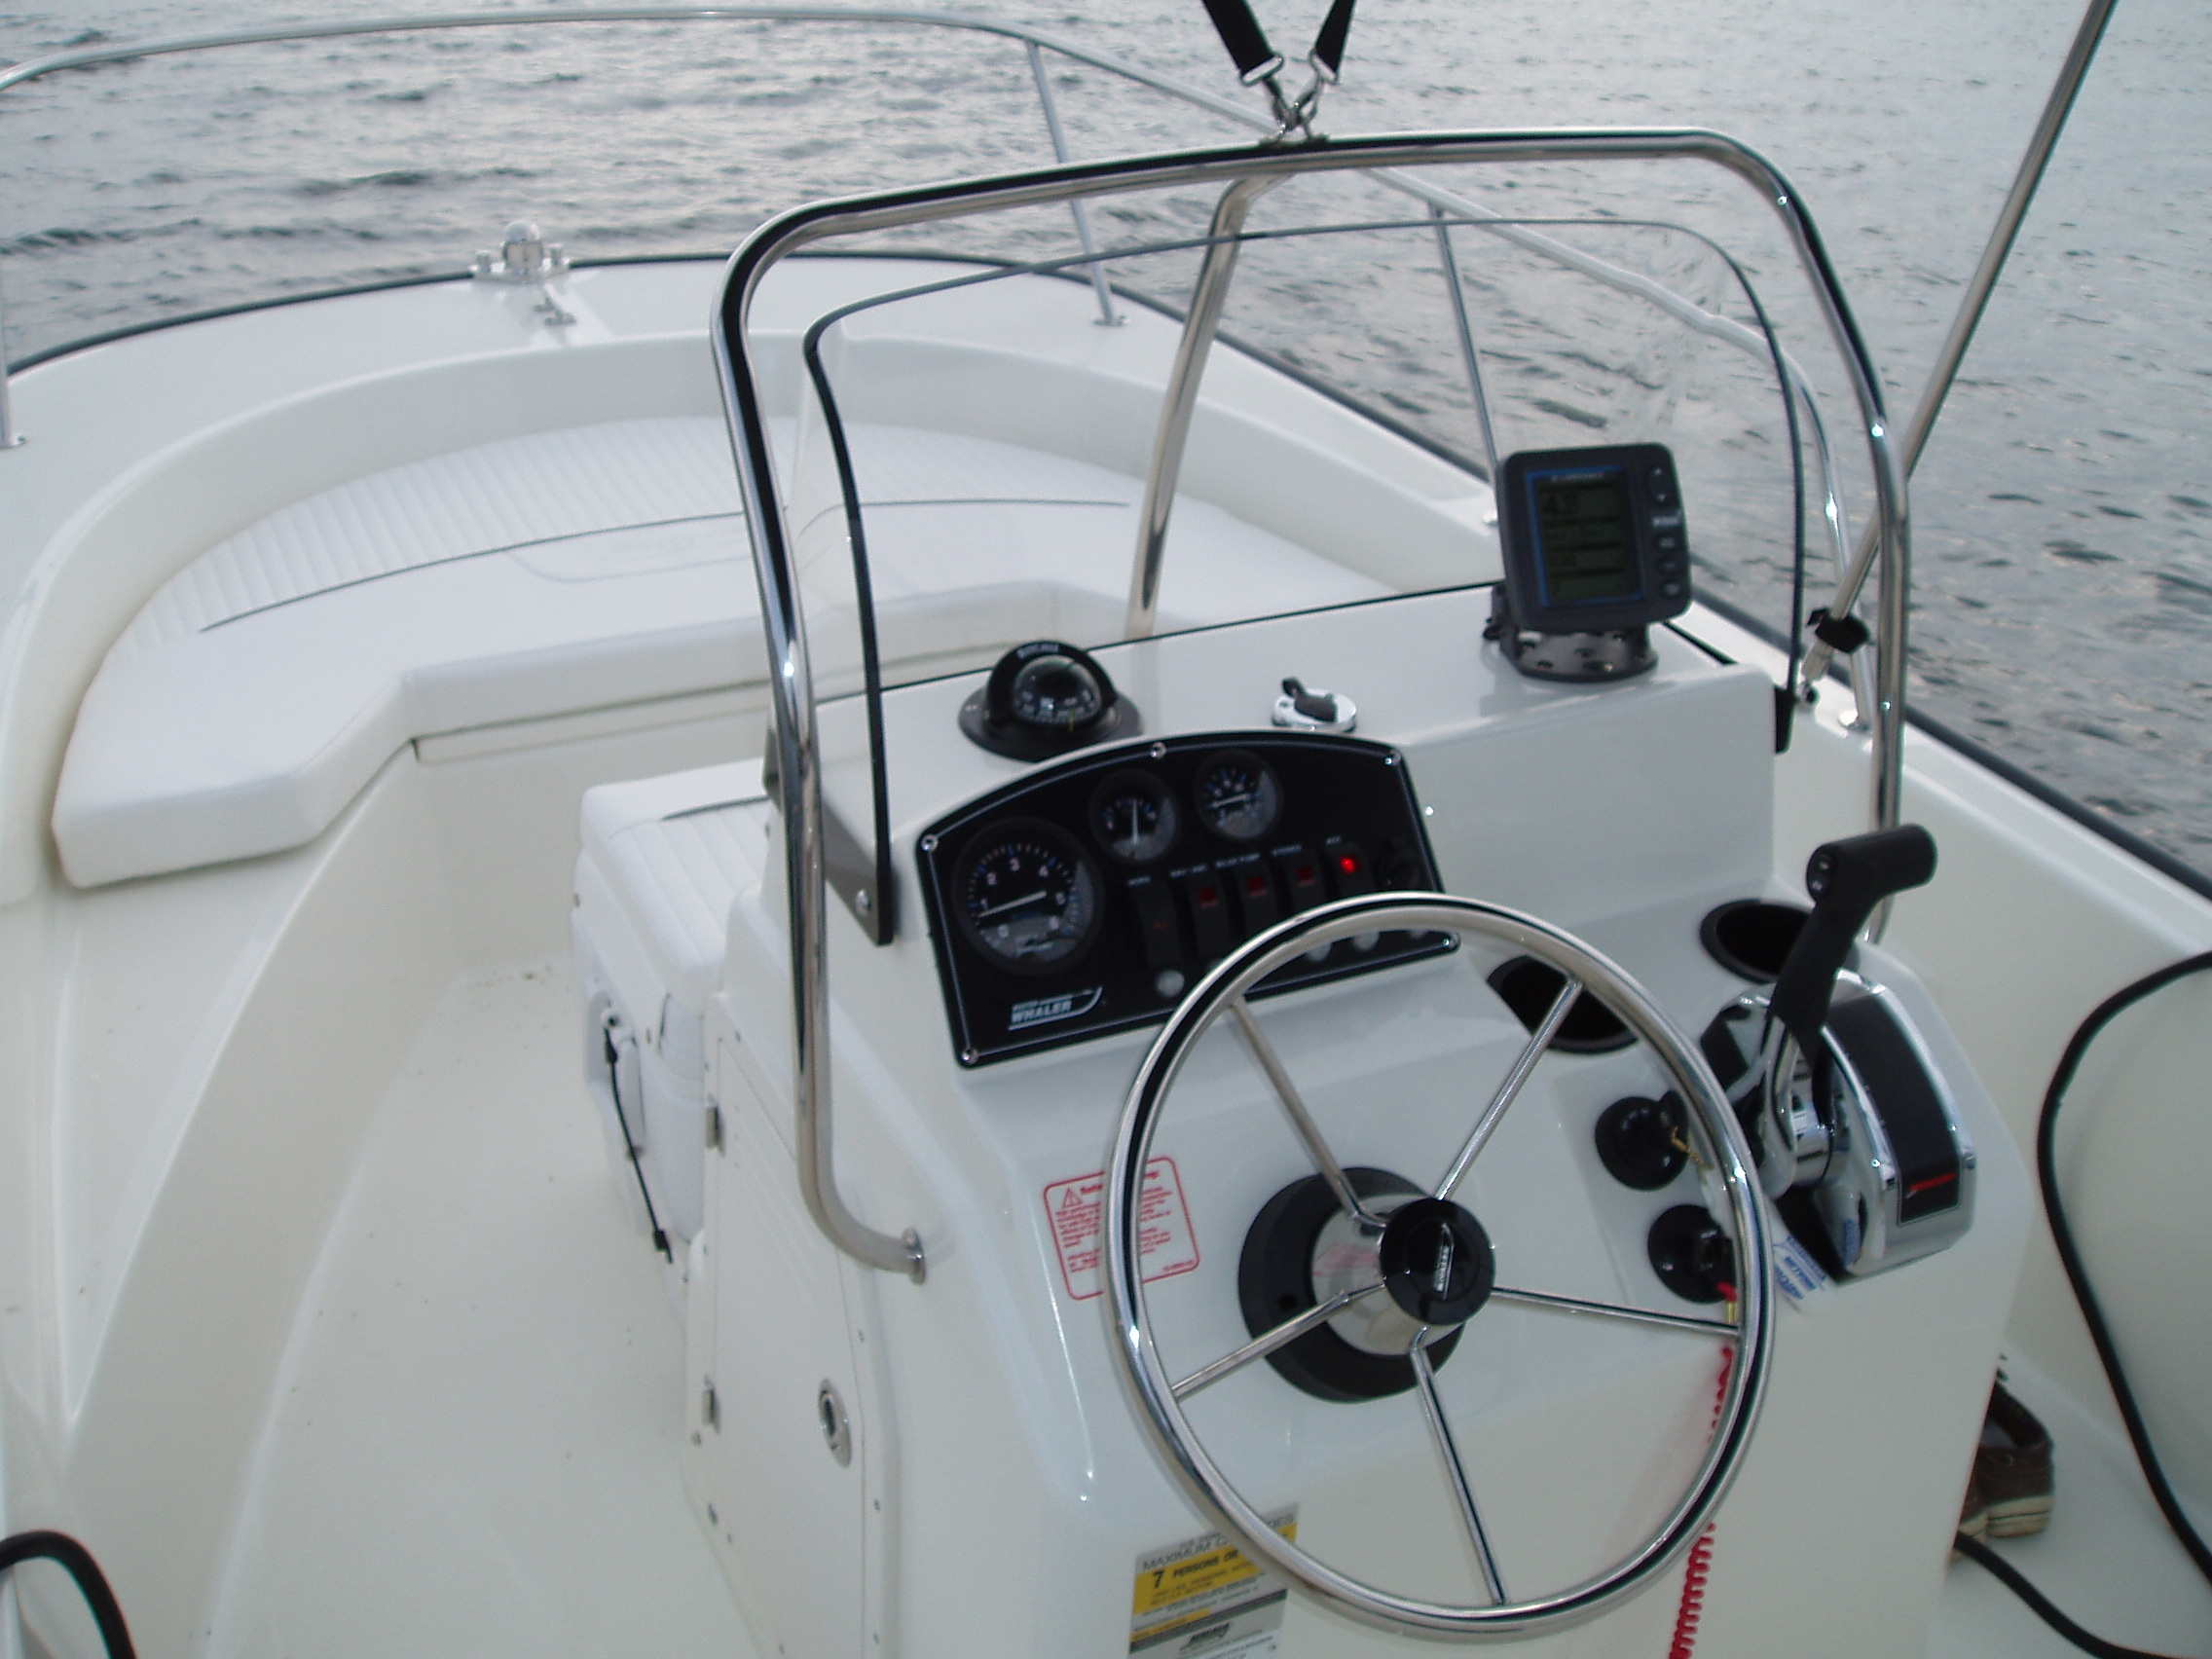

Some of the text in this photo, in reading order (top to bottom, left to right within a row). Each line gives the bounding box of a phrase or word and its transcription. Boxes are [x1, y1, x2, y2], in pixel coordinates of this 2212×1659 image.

[1009, 857, 1021, 873] 3
[1039, 865, 1050, 878] 4
[986, 871, 998, 886] 2
[1011, 1000, 1072, 1023] WHALER
[1152, 1569, 1165, 1589] 7
